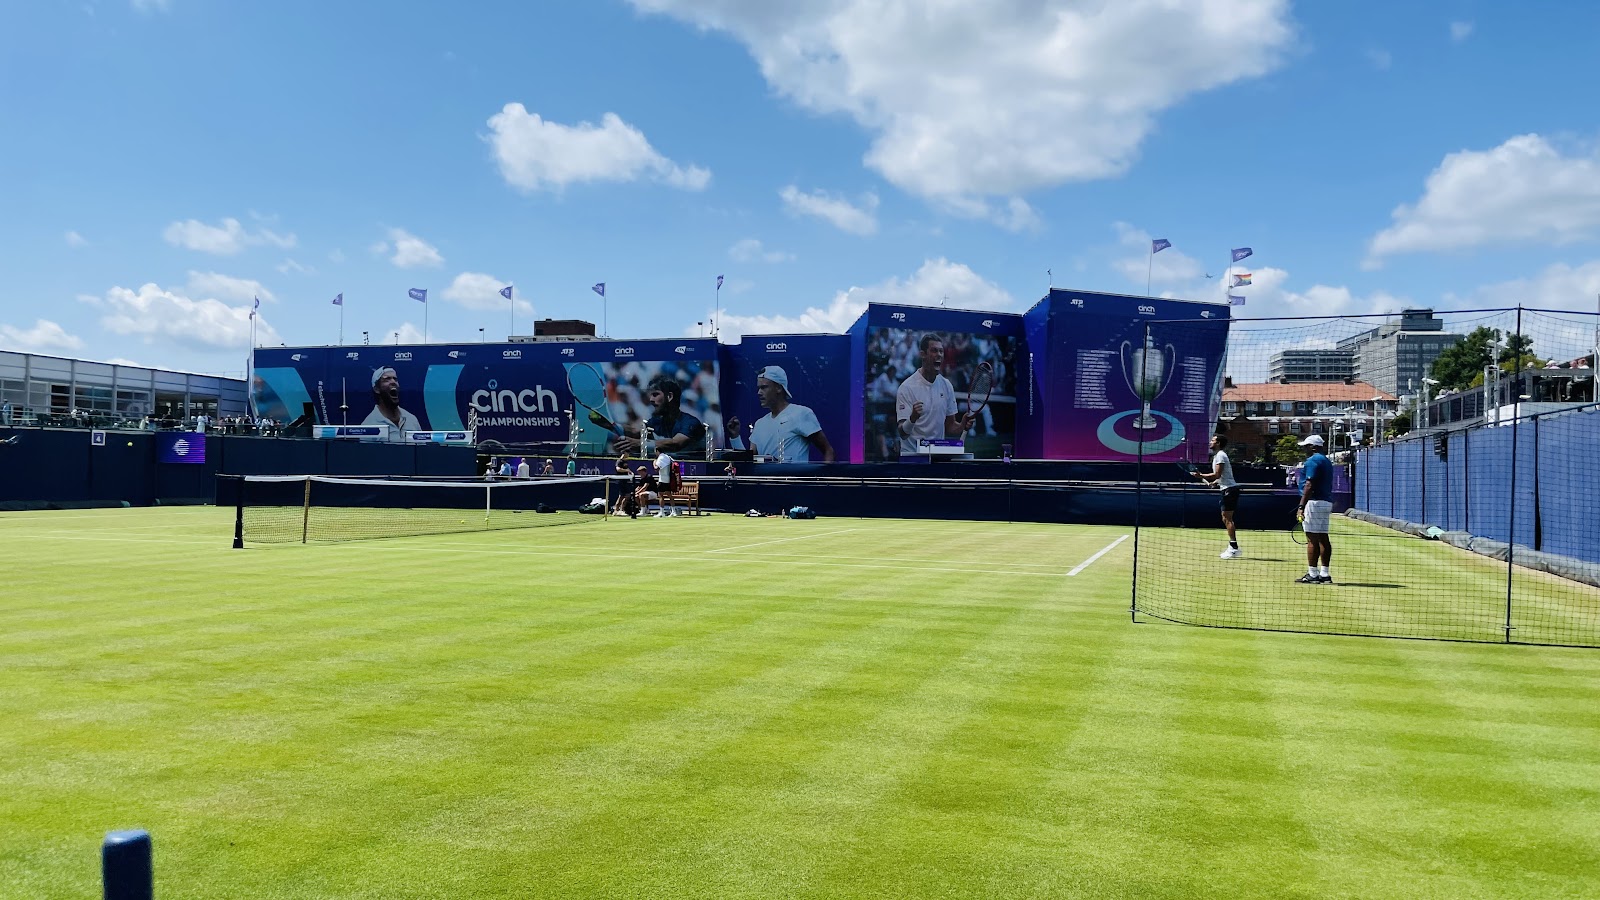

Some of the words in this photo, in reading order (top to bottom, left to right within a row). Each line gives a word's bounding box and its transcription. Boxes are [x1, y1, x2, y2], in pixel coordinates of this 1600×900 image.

[1138, 304, 1156, 312] cinch
[614, 346, 635, 354] cinch
[766, 342, 787, 351] cinch
[394, 351, 413, 359] cinch
[502, 349, 522, 357] cinch
[471, 380, 559, 412] cinch
[475, 417, 561, 427] CHAMPIONSHIPS
